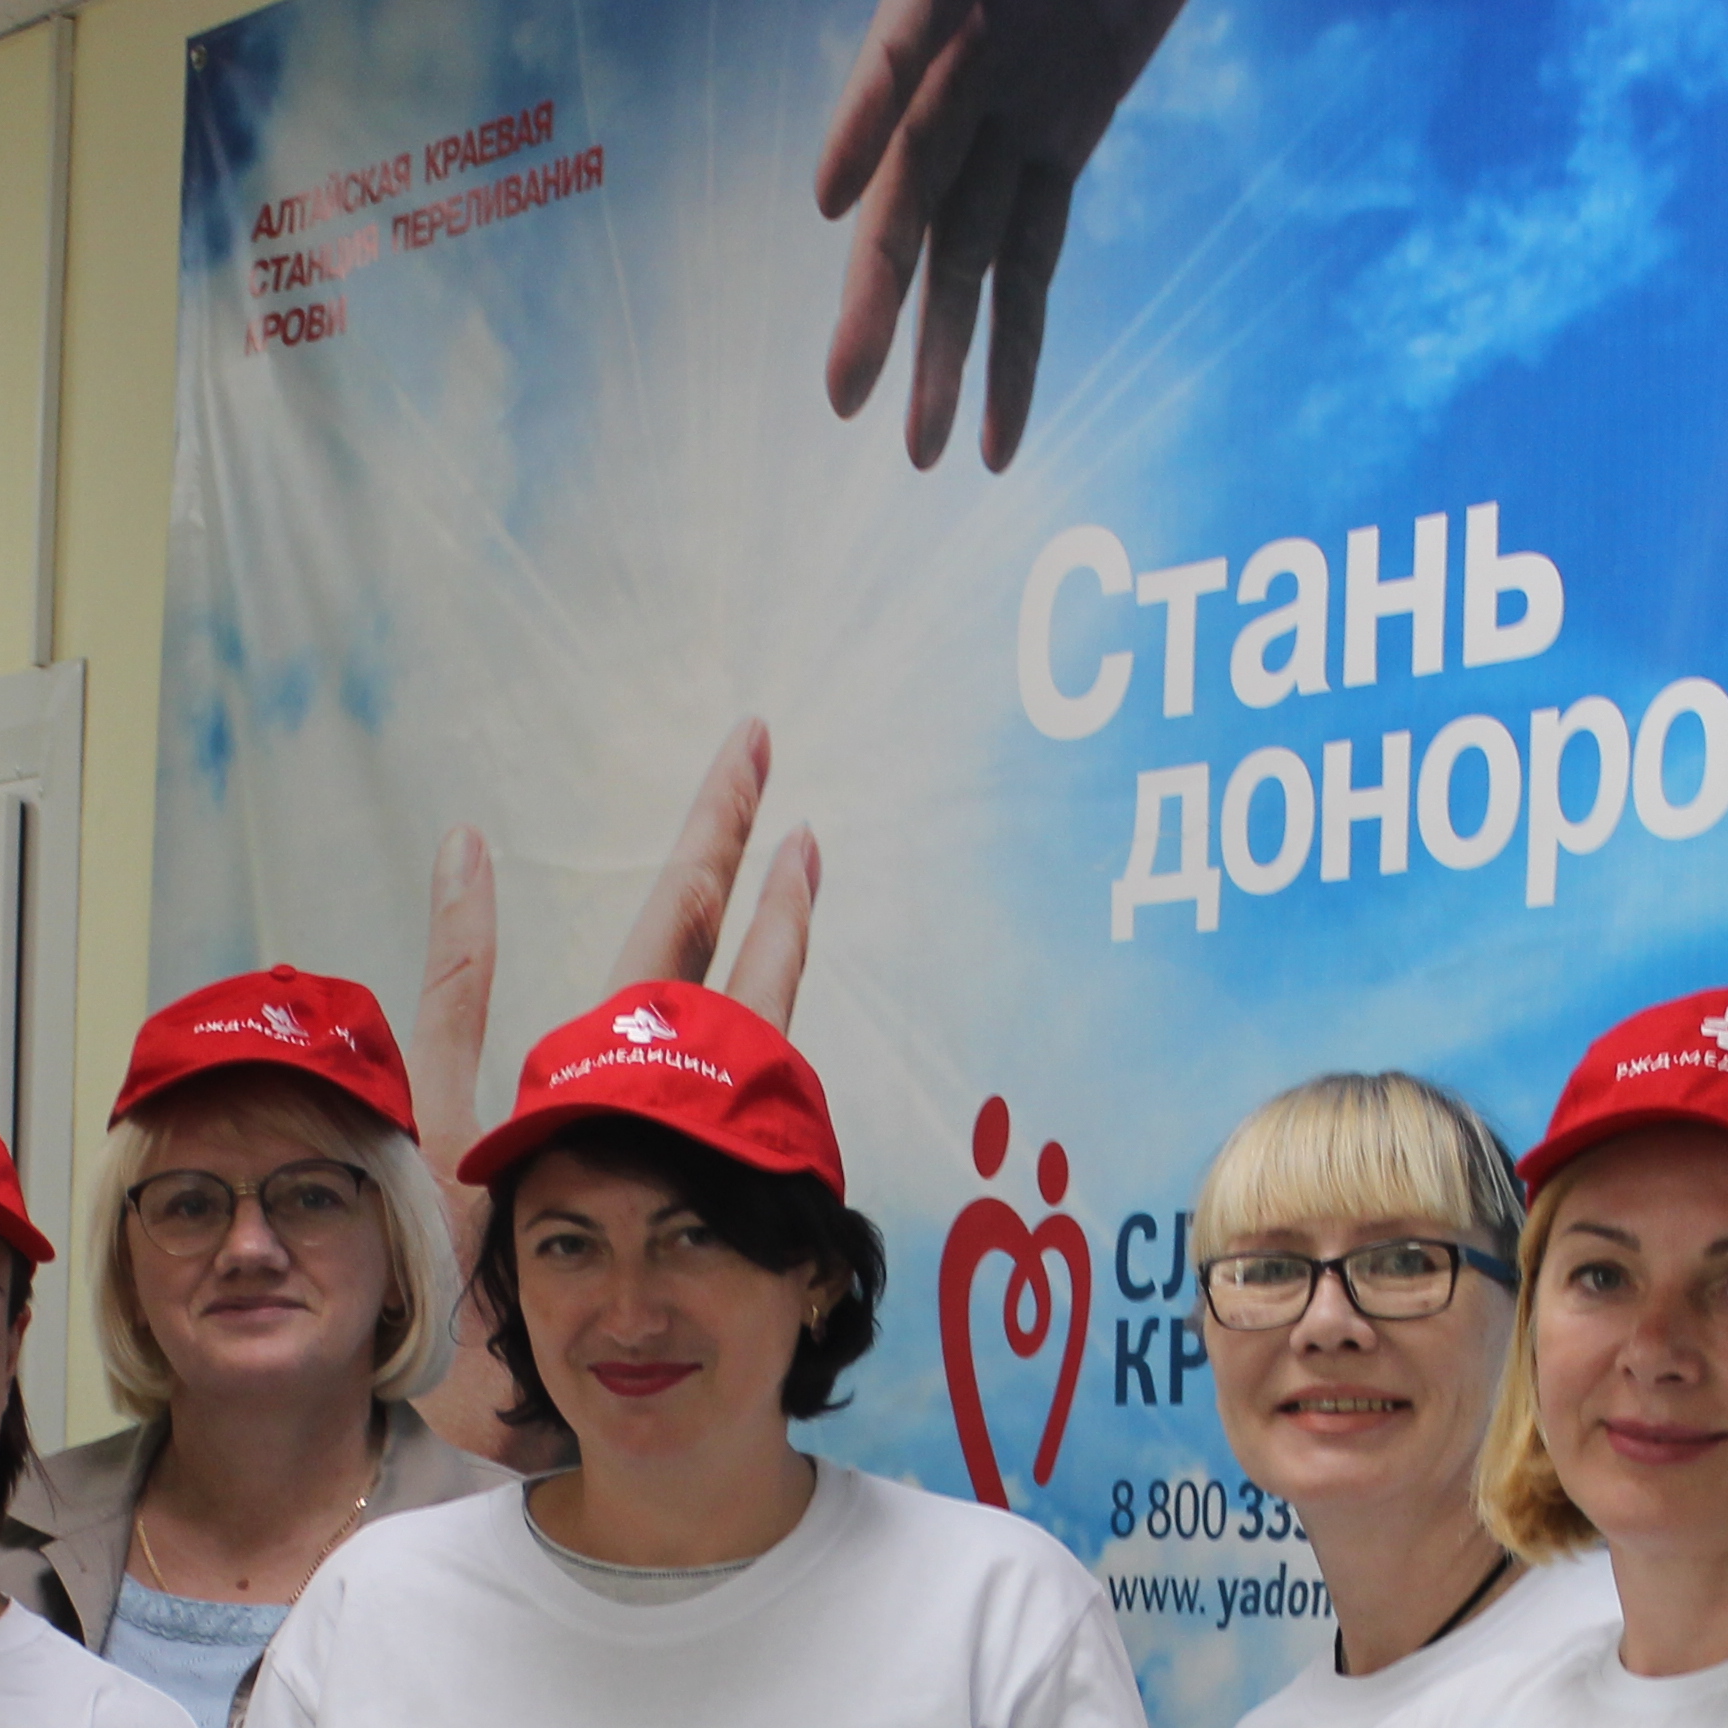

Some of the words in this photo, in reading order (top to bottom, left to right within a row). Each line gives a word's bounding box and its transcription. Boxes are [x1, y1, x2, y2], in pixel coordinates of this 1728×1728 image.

[424, 99, 556, 183] КРАЕВАЯ
[392, 144, 606, 254] ПЕРЕЛИВАНИЯ
[1016, 500, 1565, 741] Стань
[1110, 1478, 1135, 1541] 8
[1147, 1479, 1228, 1541] 800
